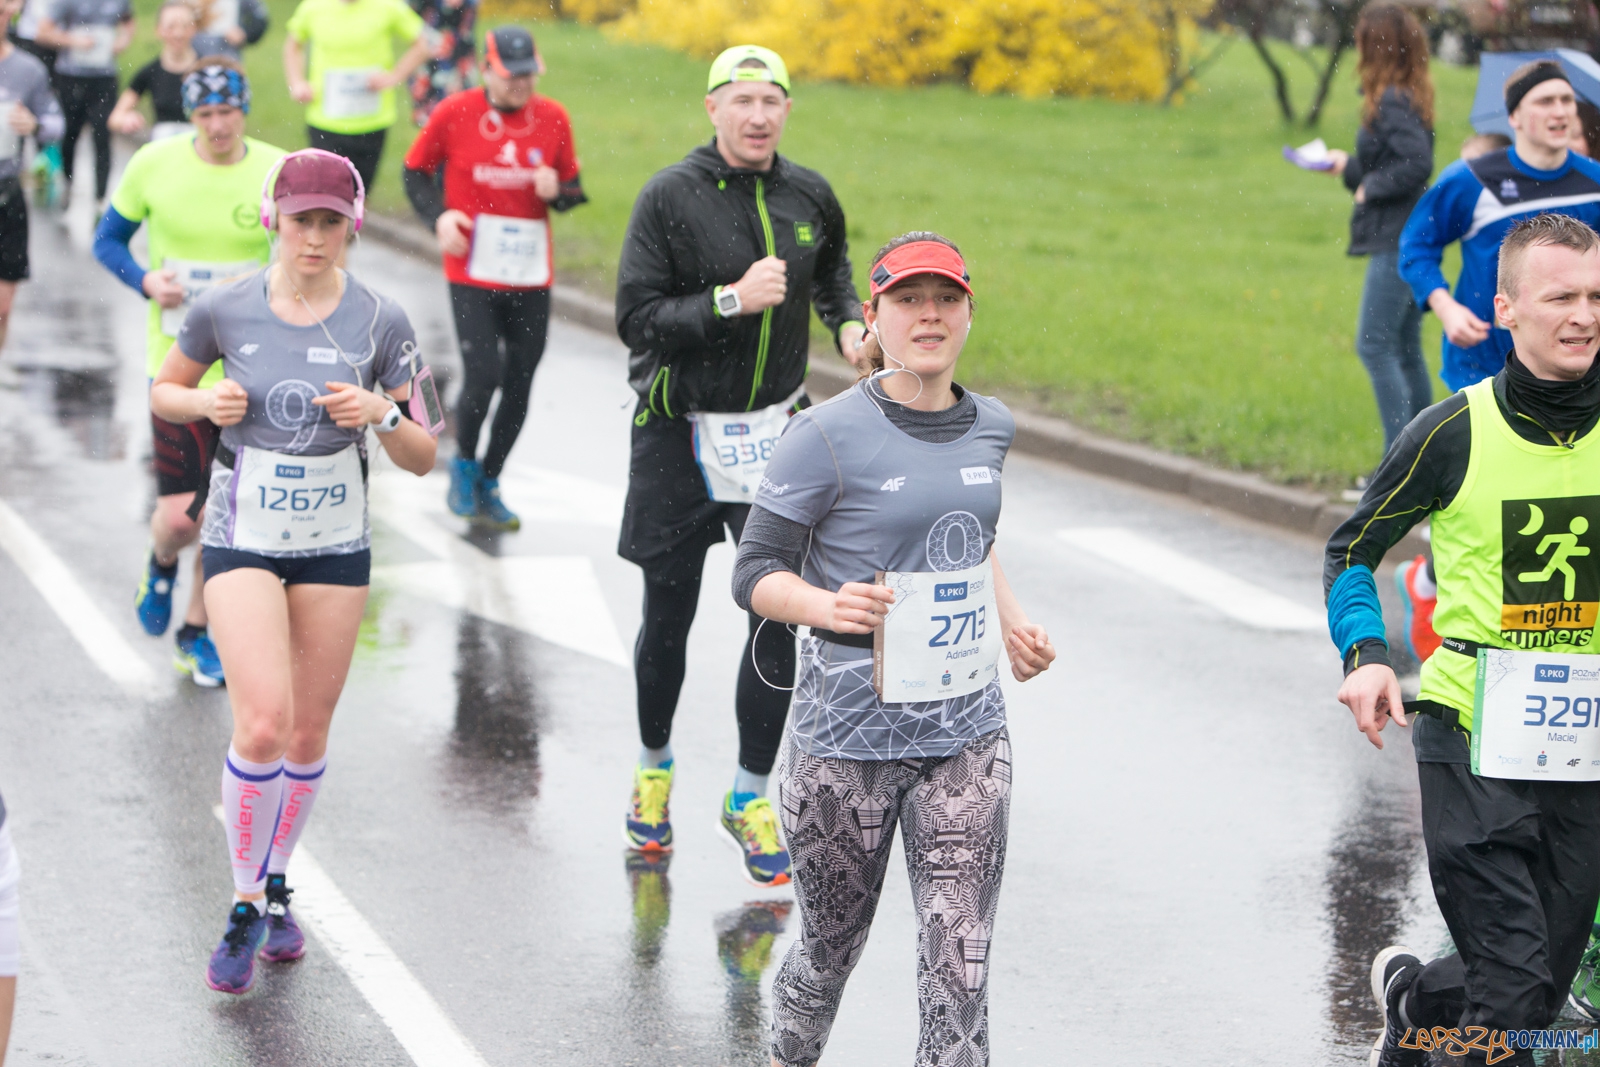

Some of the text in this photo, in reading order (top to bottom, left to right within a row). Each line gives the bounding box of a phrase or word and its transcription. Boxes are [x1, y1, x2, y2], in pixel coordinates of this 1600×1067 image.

[258, 484, 347, 511] 12679
[939, 587, 964, 597] 9.PKO
[1523, 602, 1582, 629] night
[928, 605, 986, 648] 2713
[1443, 637, 1467, 652] alenji
[1501, 629, 1593, 649] runners
[945, 646, 980, 660] Adrianna
[1540, 669, 1565, 679] 9.PKO
[1523, 694, 1600, 728] 3291
[1547, 732, 1578, 744] Maciej
